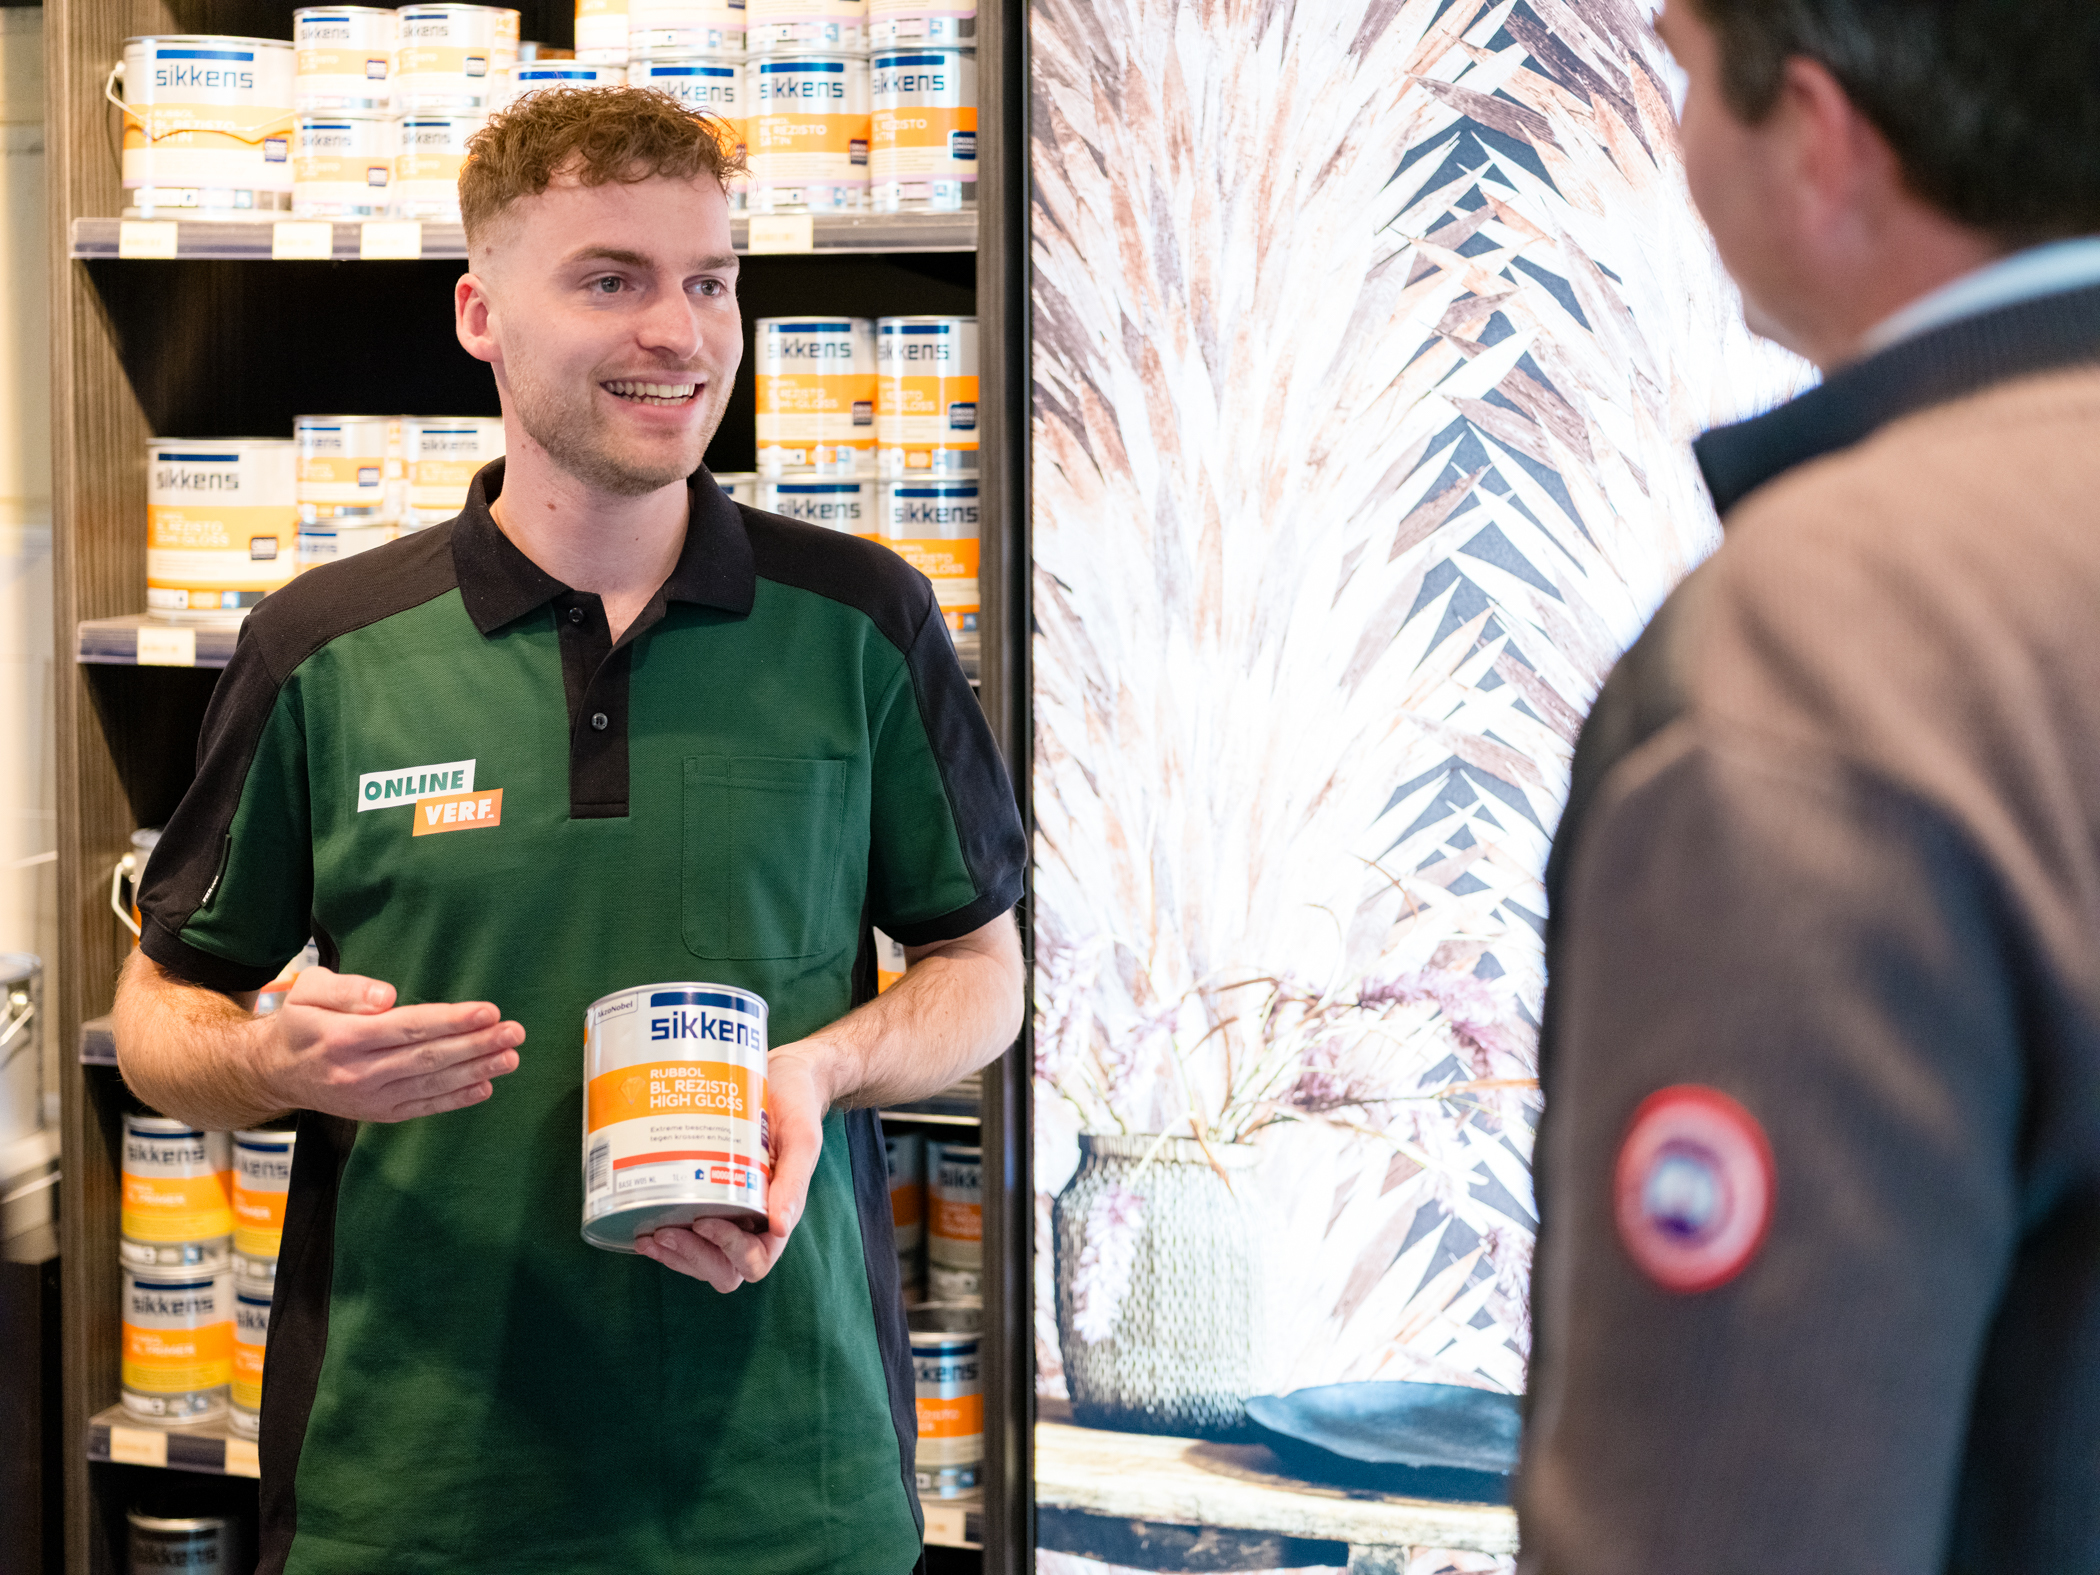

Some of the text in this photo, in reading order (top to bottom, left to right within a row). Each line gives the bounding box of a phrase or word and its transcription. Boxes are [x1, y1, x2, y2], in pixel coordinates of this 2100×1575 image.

[156, 65, 253, 89] sikkens
[873, 74, 945, 95] sikkens
[661, 81, 734, 103] kkens
[760, 77, 845, 99] sikkens
[768, 338, 852, 359] sikkens
[157, 468, 239, 490] sikkens
[777, 499, 861, 520] sikkens
[894, 502, 979, 523] sikkens
[364, 770, 465, 801] ONLINE
[597, 1000, 633, 1018] AkzoNobel
[651, 1011, 760, 1051] sikkens
[650, 1067, 705, 1079] RUBBOL
[650, 1079, 739, 1097] BL REZISTO
[650, 1093, 744, 1111] HIGH GLOSS
[650, 1125, 683, 1133] Extreme
[916, 1361, 979, 1384] kens
